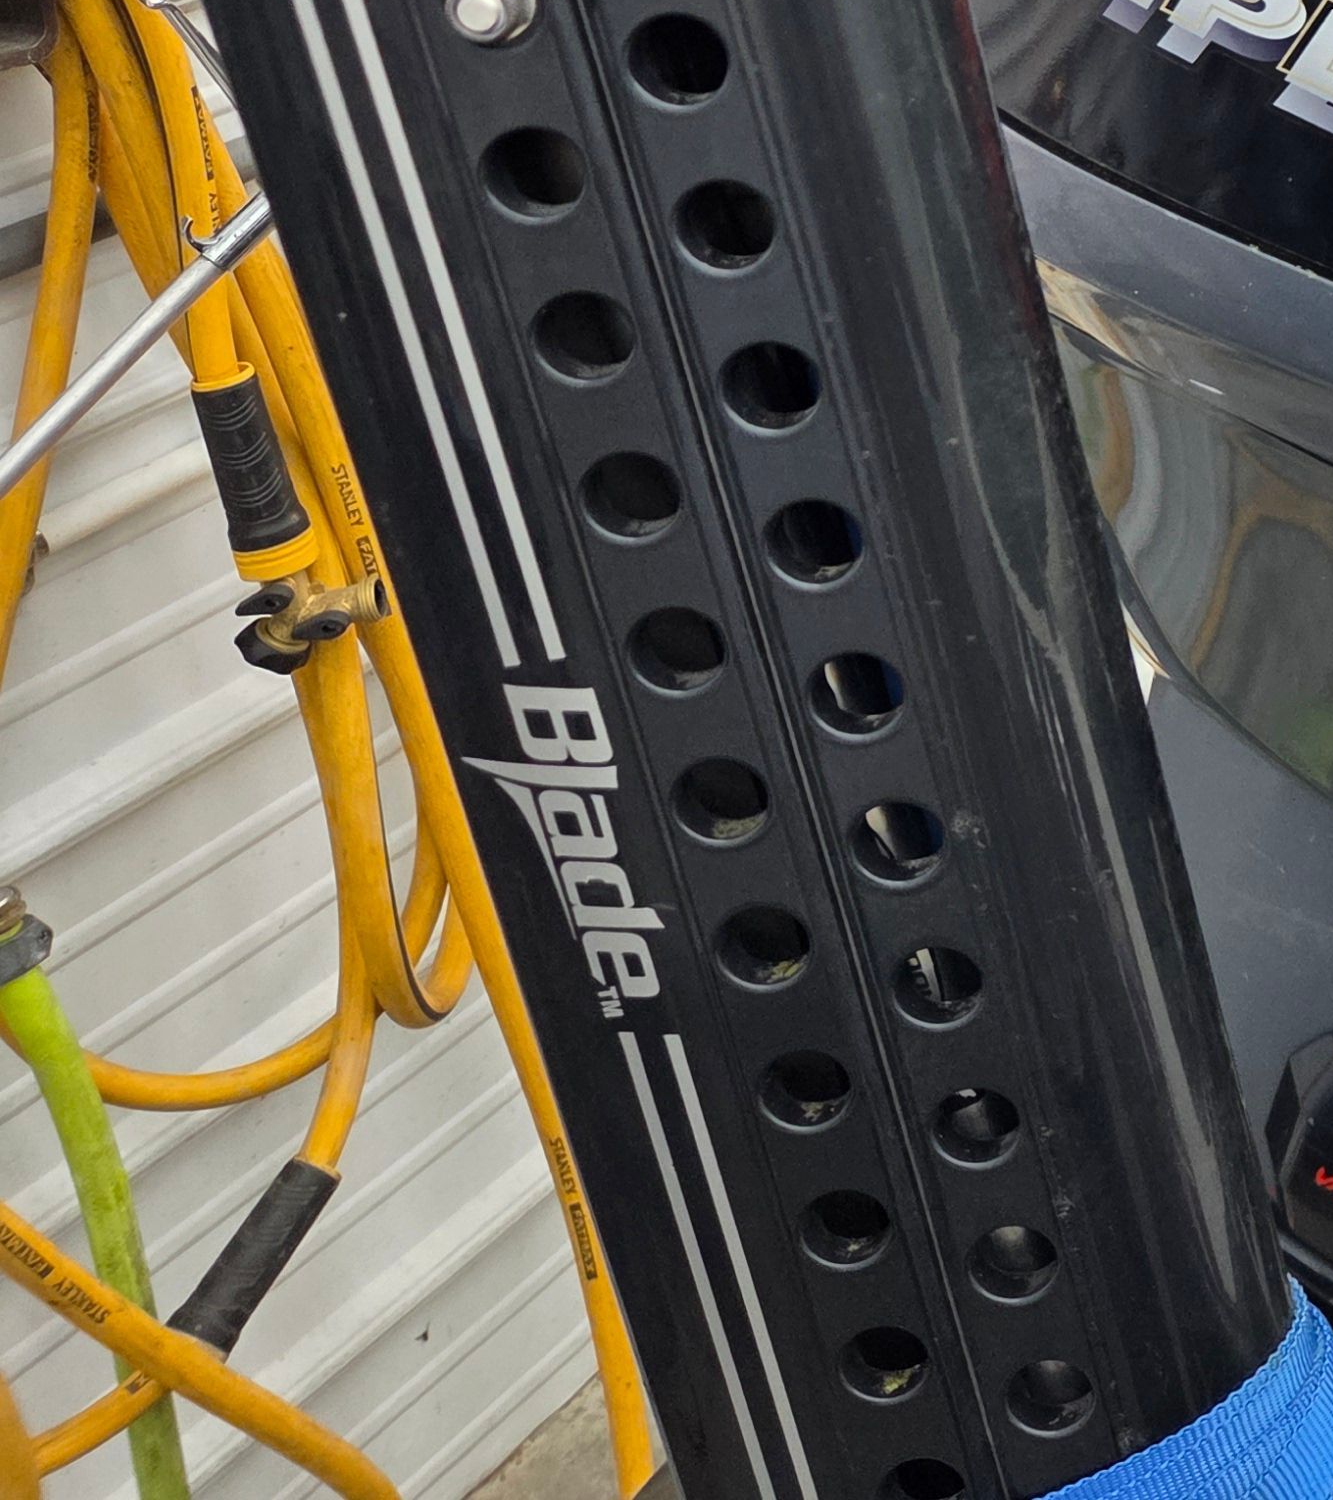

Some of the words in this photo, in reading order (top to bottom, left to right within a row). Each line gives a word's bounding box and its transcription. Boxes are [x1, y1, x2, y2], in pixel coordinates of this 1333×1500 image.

[331, 463, 365, 527] STANLEY
[461, 683, 665, 998] Blade
[550, 1137, 577, 1195] STANLEY
[0, 1222, 50, 1278] FATMA
[53, 1276, 112, 1324] STANLEY
